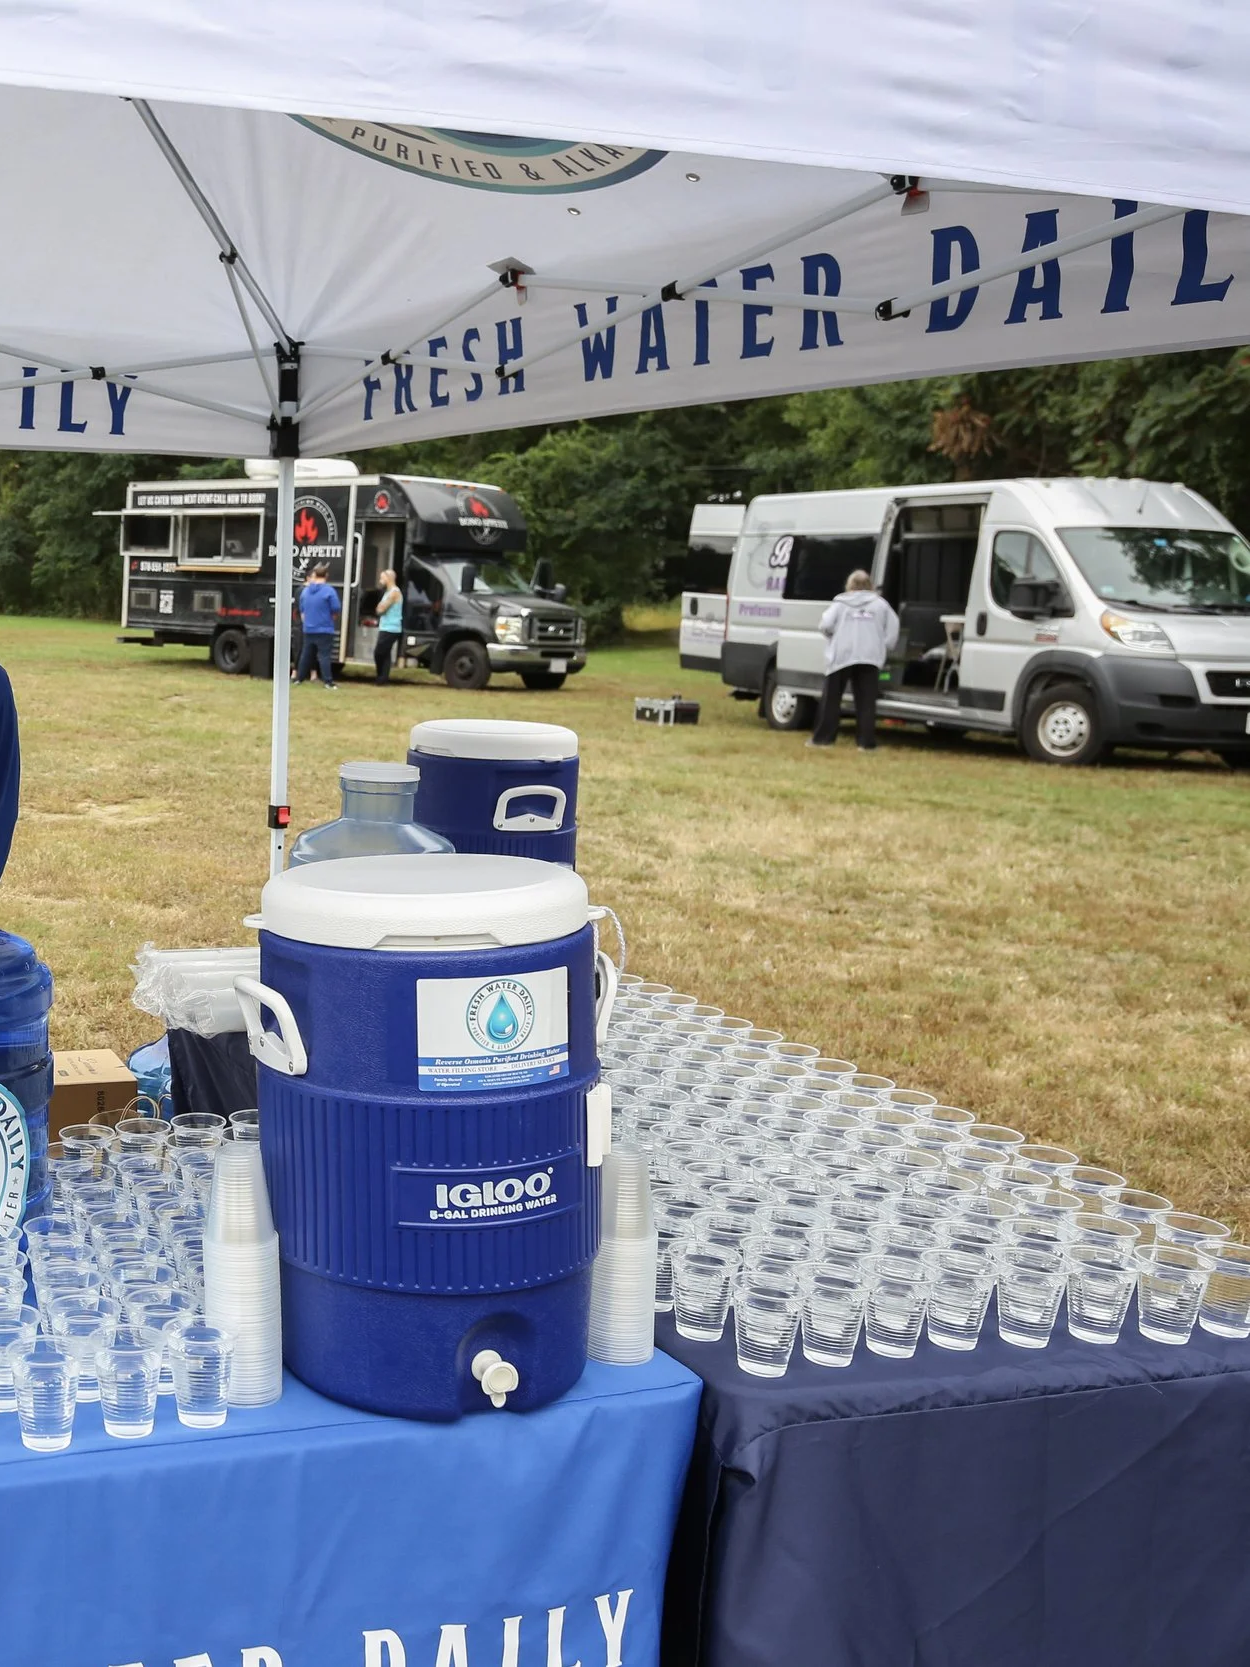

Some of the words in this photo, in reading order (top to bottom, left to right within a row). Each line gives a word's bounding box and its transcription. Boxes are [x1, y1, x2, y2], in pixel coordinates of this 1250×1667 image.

[351, 125, 503, 181] PURIFIED
[518, 162, 545, 182] &
[551, 142, 634, 178] ALKA
[363, 316, 526, 422] FRESH
[573, 252, 844, 383] WATER
[469, 993, 485, 1022] FRESH
[486, 981, 518, 994] WATER
[519, 988, 533, 1017] DAILY
[427, 1066, 451, 1074] WATER
[452, 1065, 477, 1074] FILLING
[478, 1065, 497, 1073] STORE
[511, 1060, 536, 1070] DELIVERY
[435, 1057, 463, 1066] Reverse
[464, 1056, 492, 1066] Osmosis
[492, 1053, 519, 1064] Purified
[520, 1048, 546, 1061] Drinking
[429, 1209, 468, 1221] 5-GAL
[471, 1202, 524, 1219] DRINKING
[526, 1193, 558, 1210] WATER
[436, 1172, 552, 1209] IGLOO
